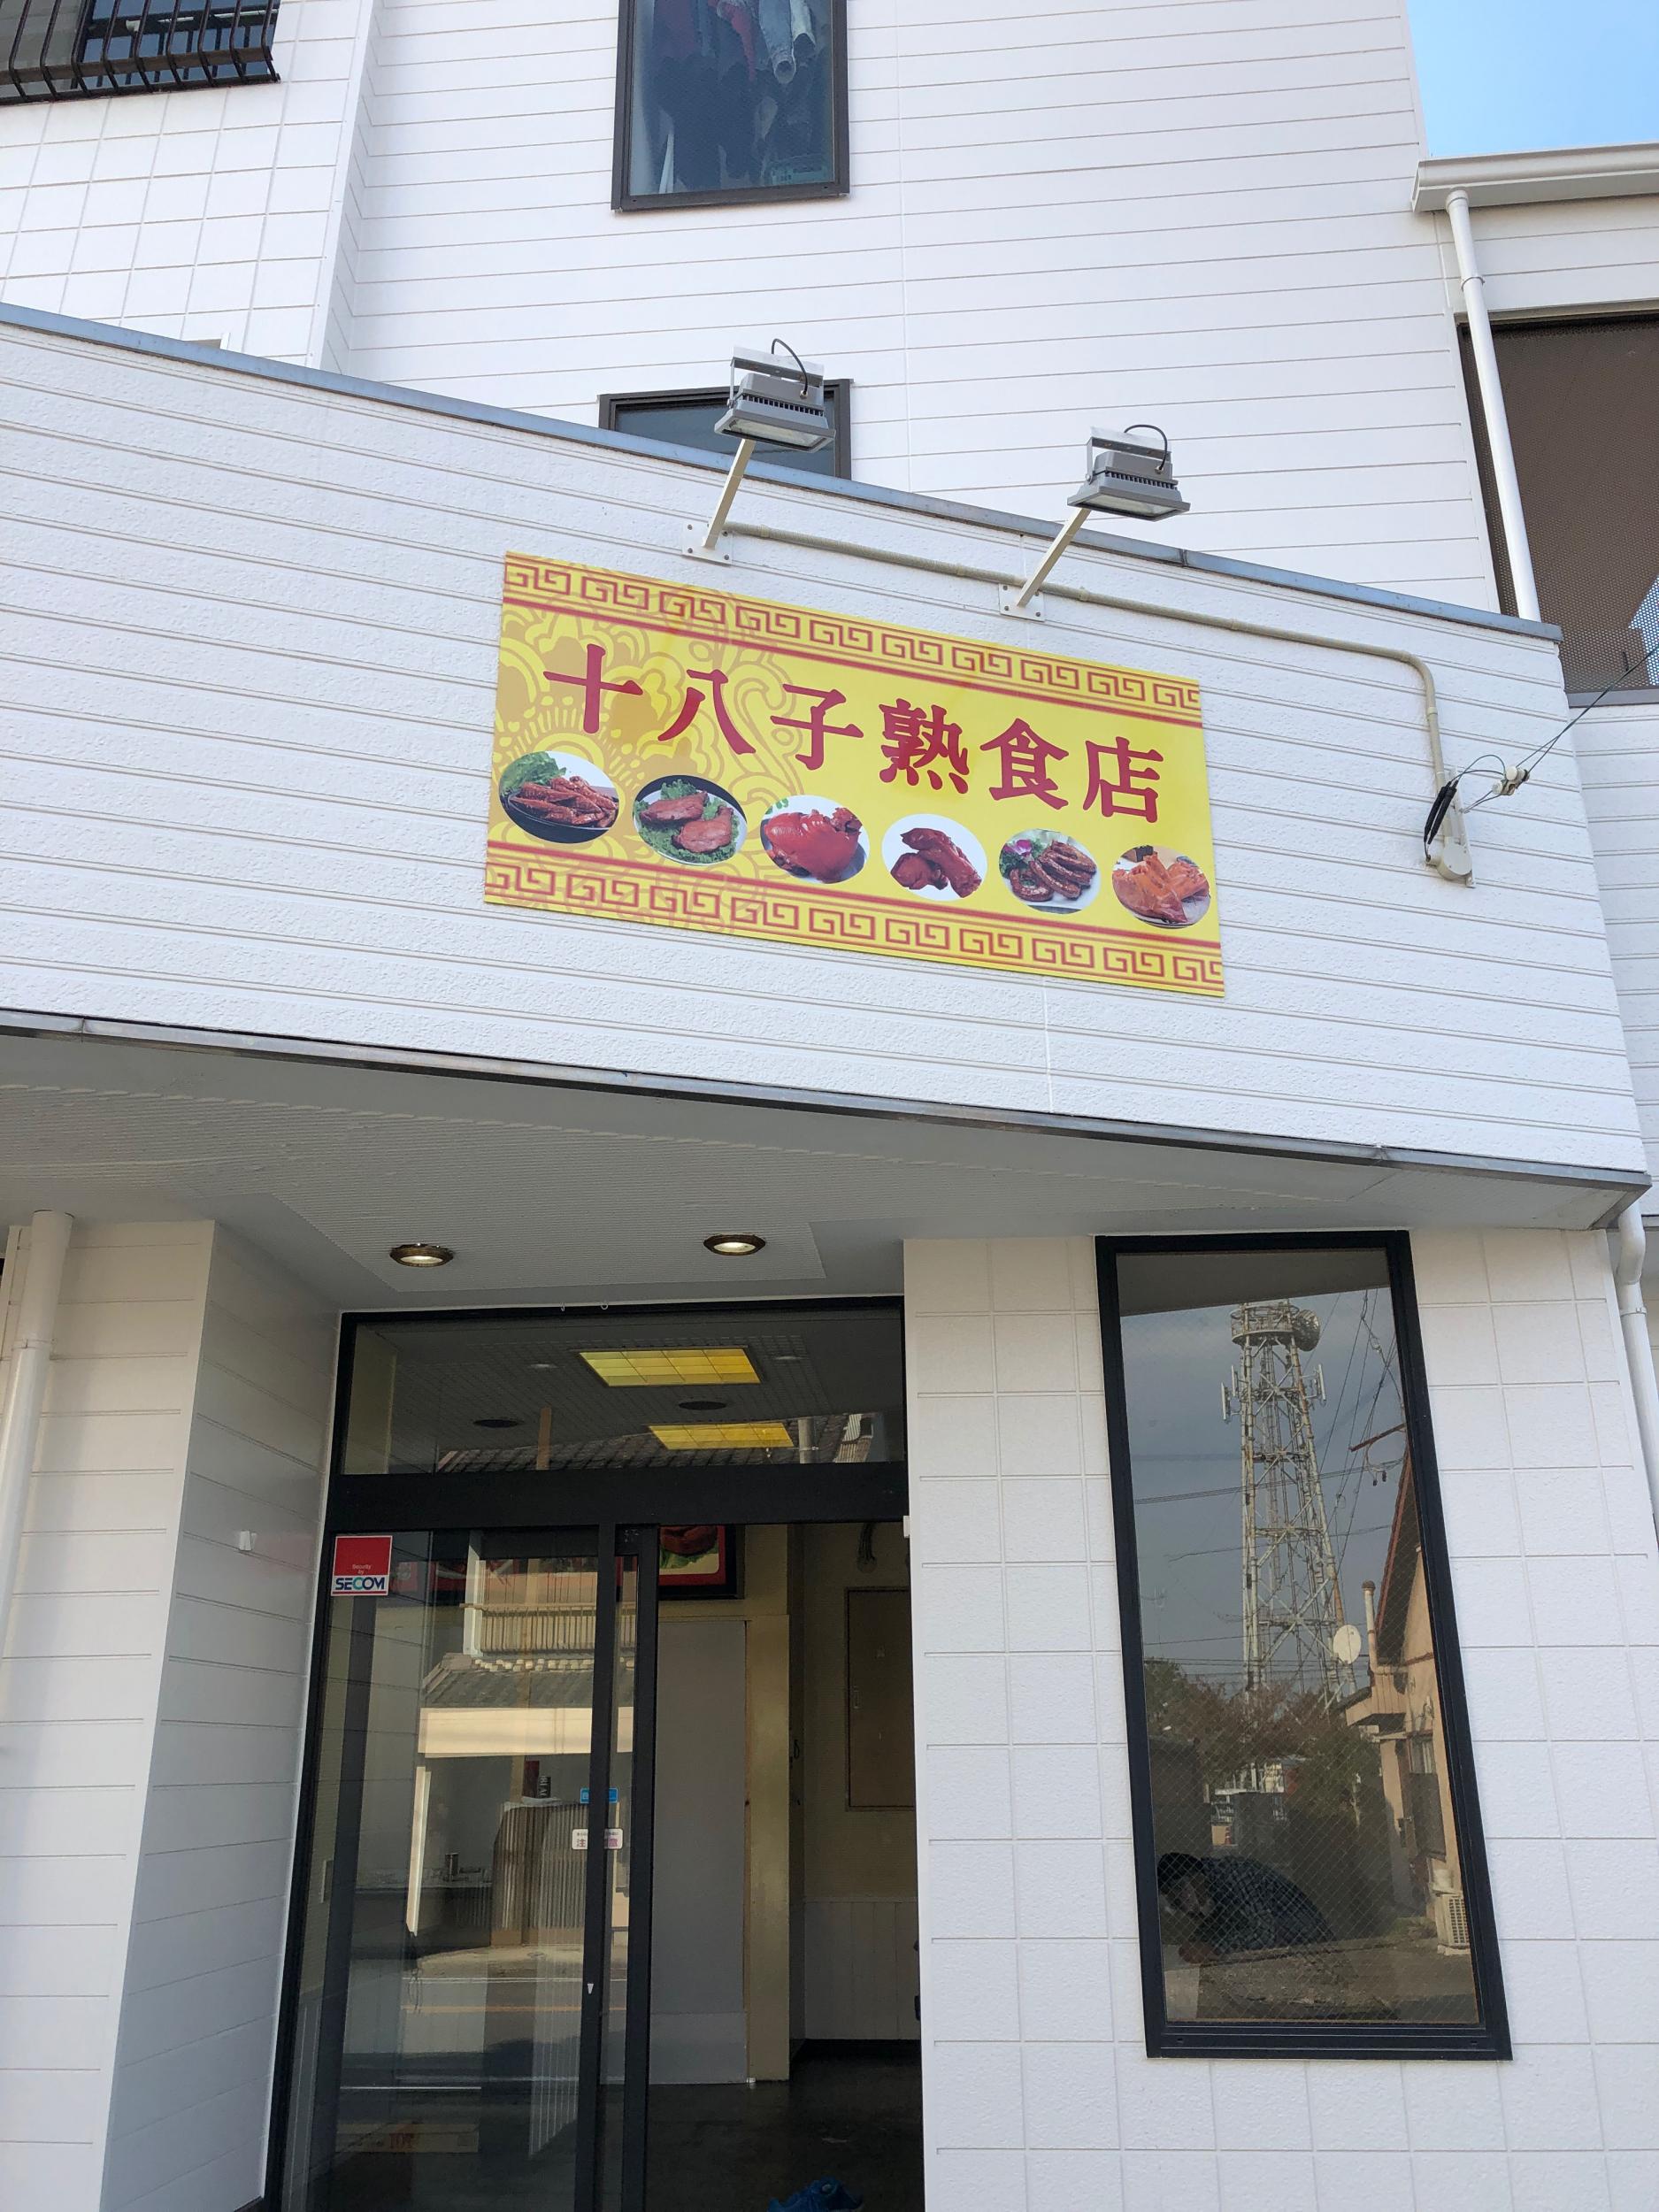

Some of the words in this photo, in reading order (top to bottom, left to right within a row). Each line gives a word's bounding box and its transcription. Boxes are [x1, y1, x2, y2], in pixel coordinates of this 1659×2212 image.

[543, 644, 1164, 824] 十八子熟食店
[335, 1577, 385, 1590] SECOM
